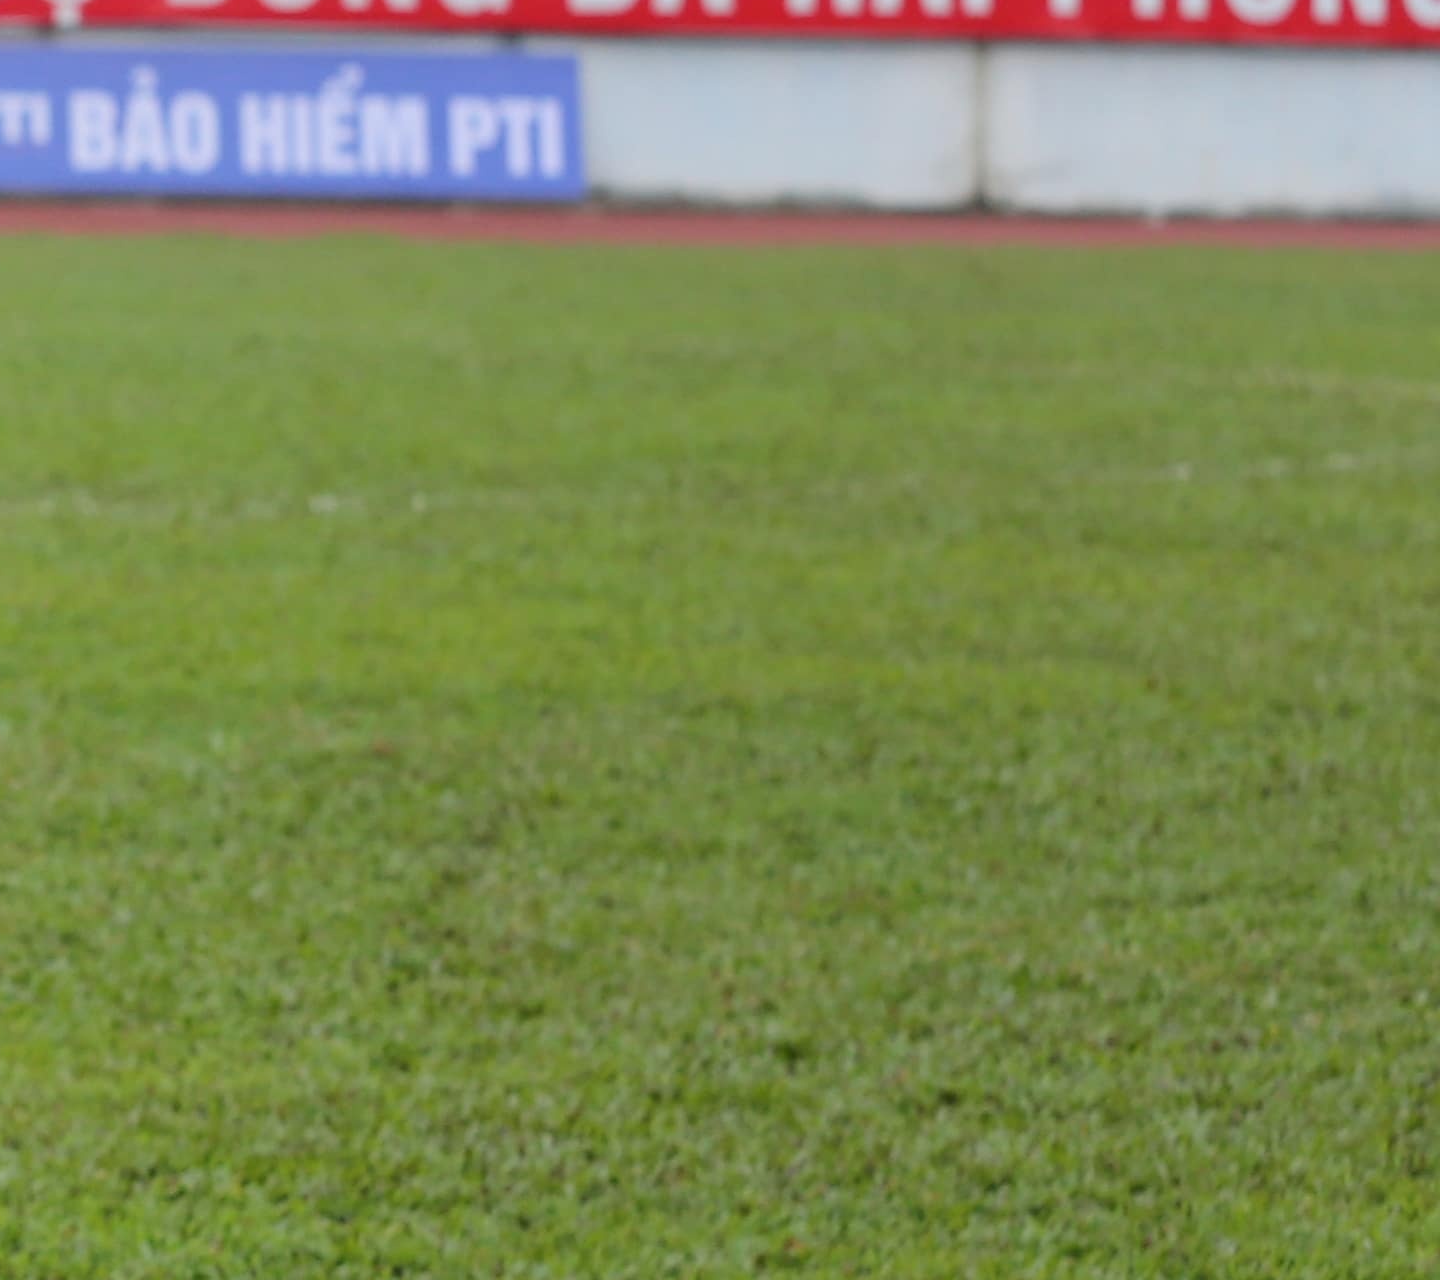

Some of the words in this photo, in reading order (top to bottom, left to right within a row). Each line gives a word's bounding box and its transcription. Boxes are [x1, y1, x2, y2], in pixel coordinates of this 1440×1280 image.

[67, 65, 221, 176] BẢO
[241, 65, 430, 177] HIỂM
[449, 95, 565, 178] PTI
